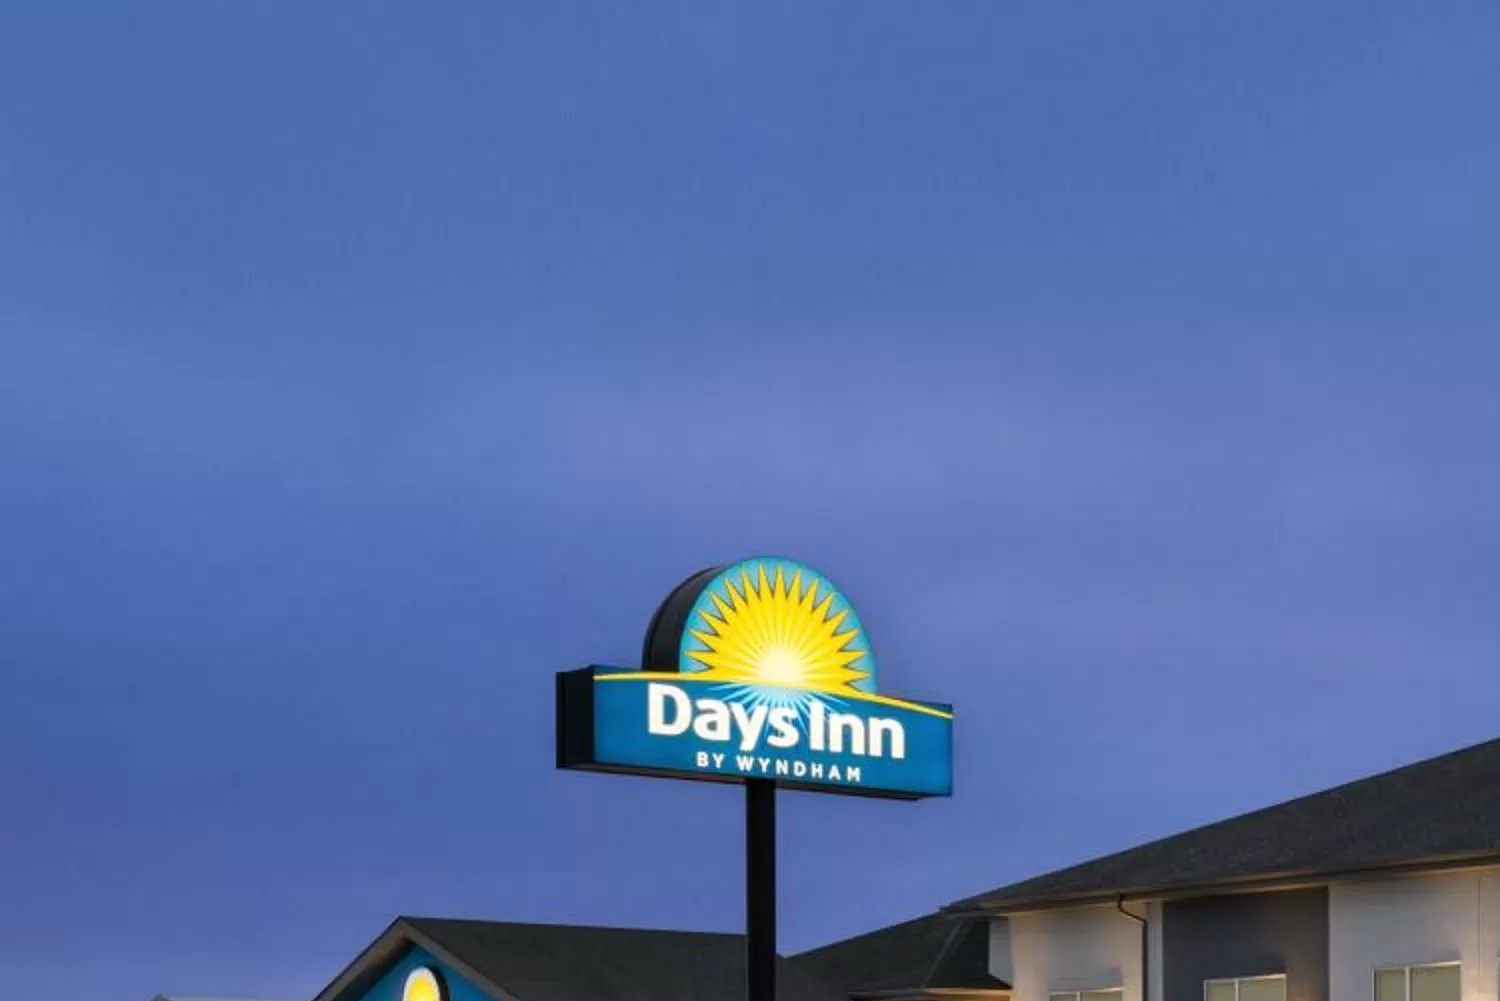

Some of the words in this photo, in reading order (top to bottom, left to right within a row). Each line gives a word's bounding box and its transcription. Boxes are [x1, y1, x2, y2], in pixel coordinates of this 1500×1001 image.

[648, 682, 799, 751] Days
[809, 701, 905, 759] Inn
[696, 751, 725, 769] BY
[736, 755, 861, 782] WYNDHAM
